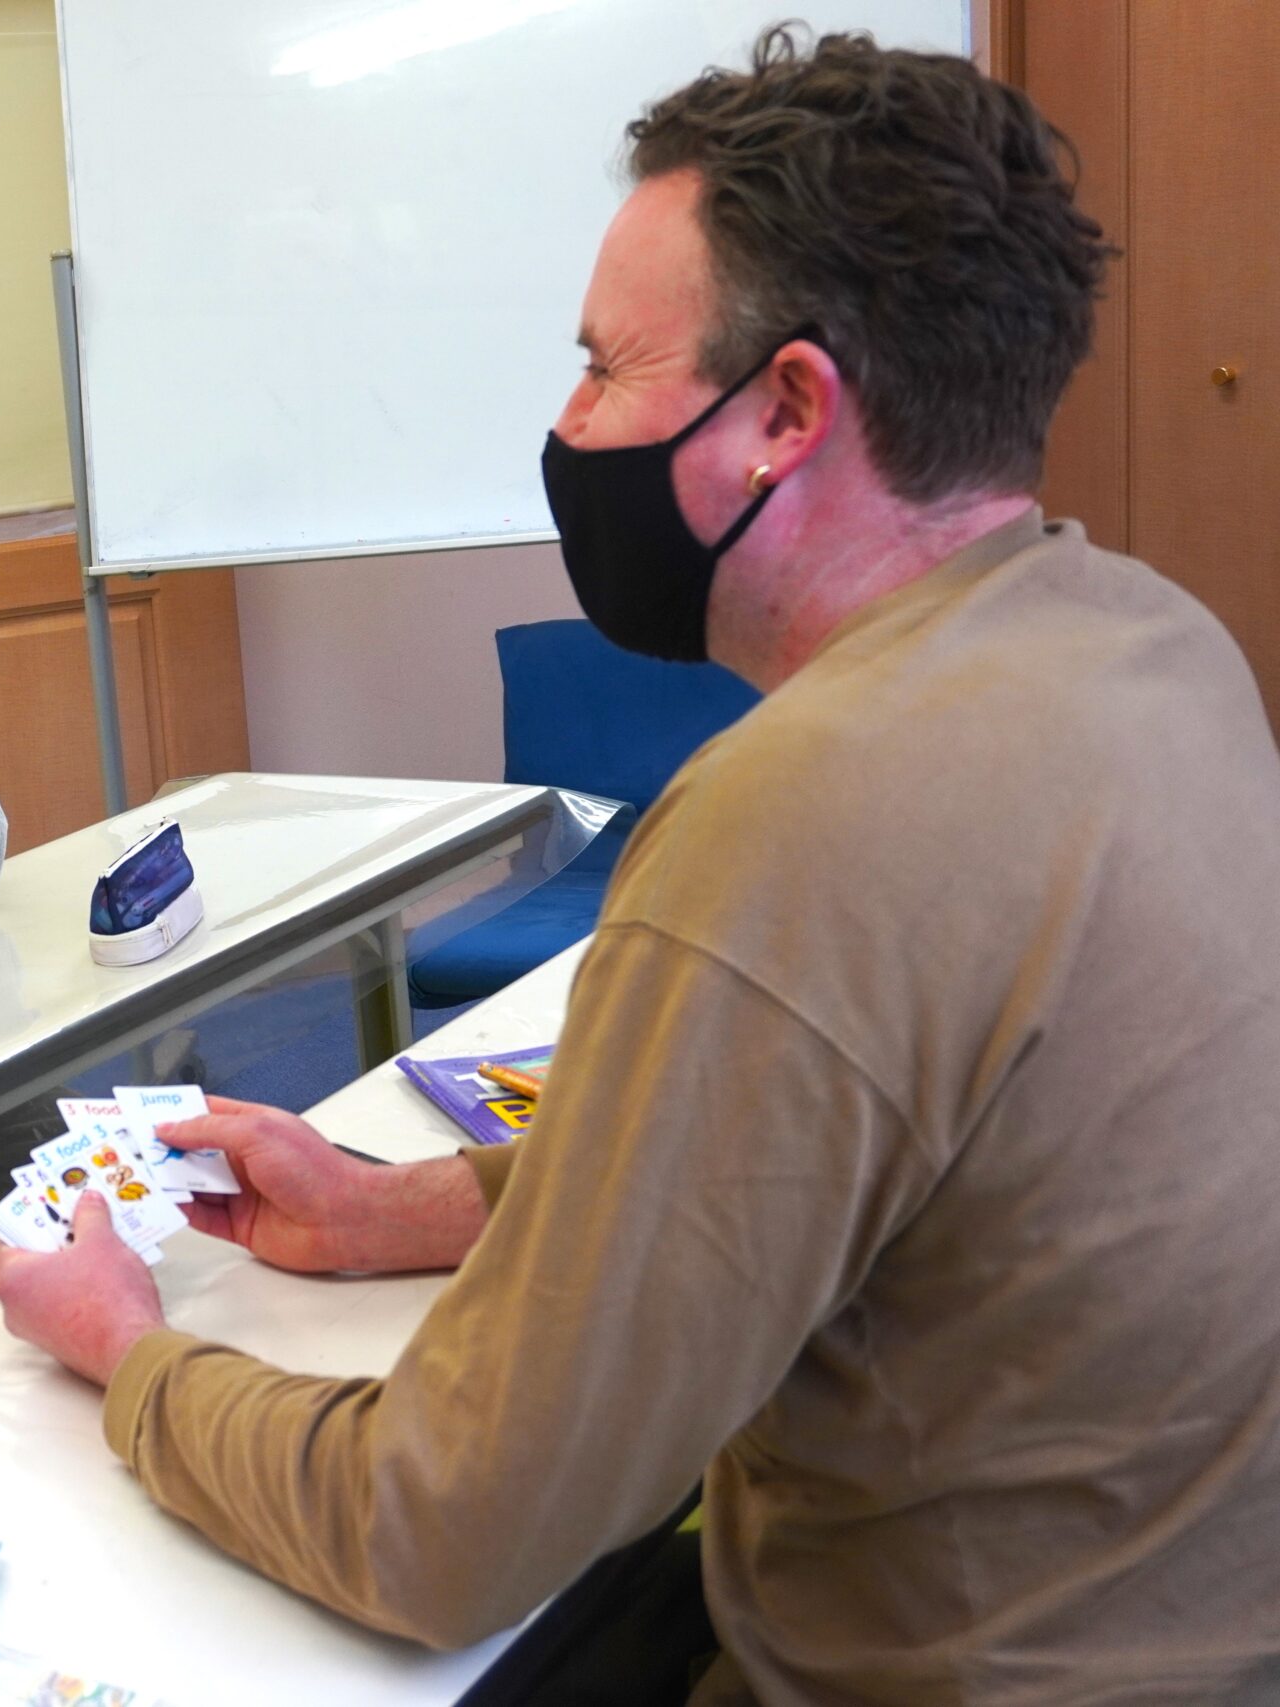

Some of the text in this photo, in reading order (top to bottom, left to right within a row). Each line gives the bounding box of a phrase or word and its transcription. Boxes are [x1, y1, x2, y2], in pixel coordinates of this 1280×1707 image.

[140, 1093, 182, 1107] jump
[65, 1104, 122, 1116] 3 food
[39, 1124, 108, 1168] 3 food 3
